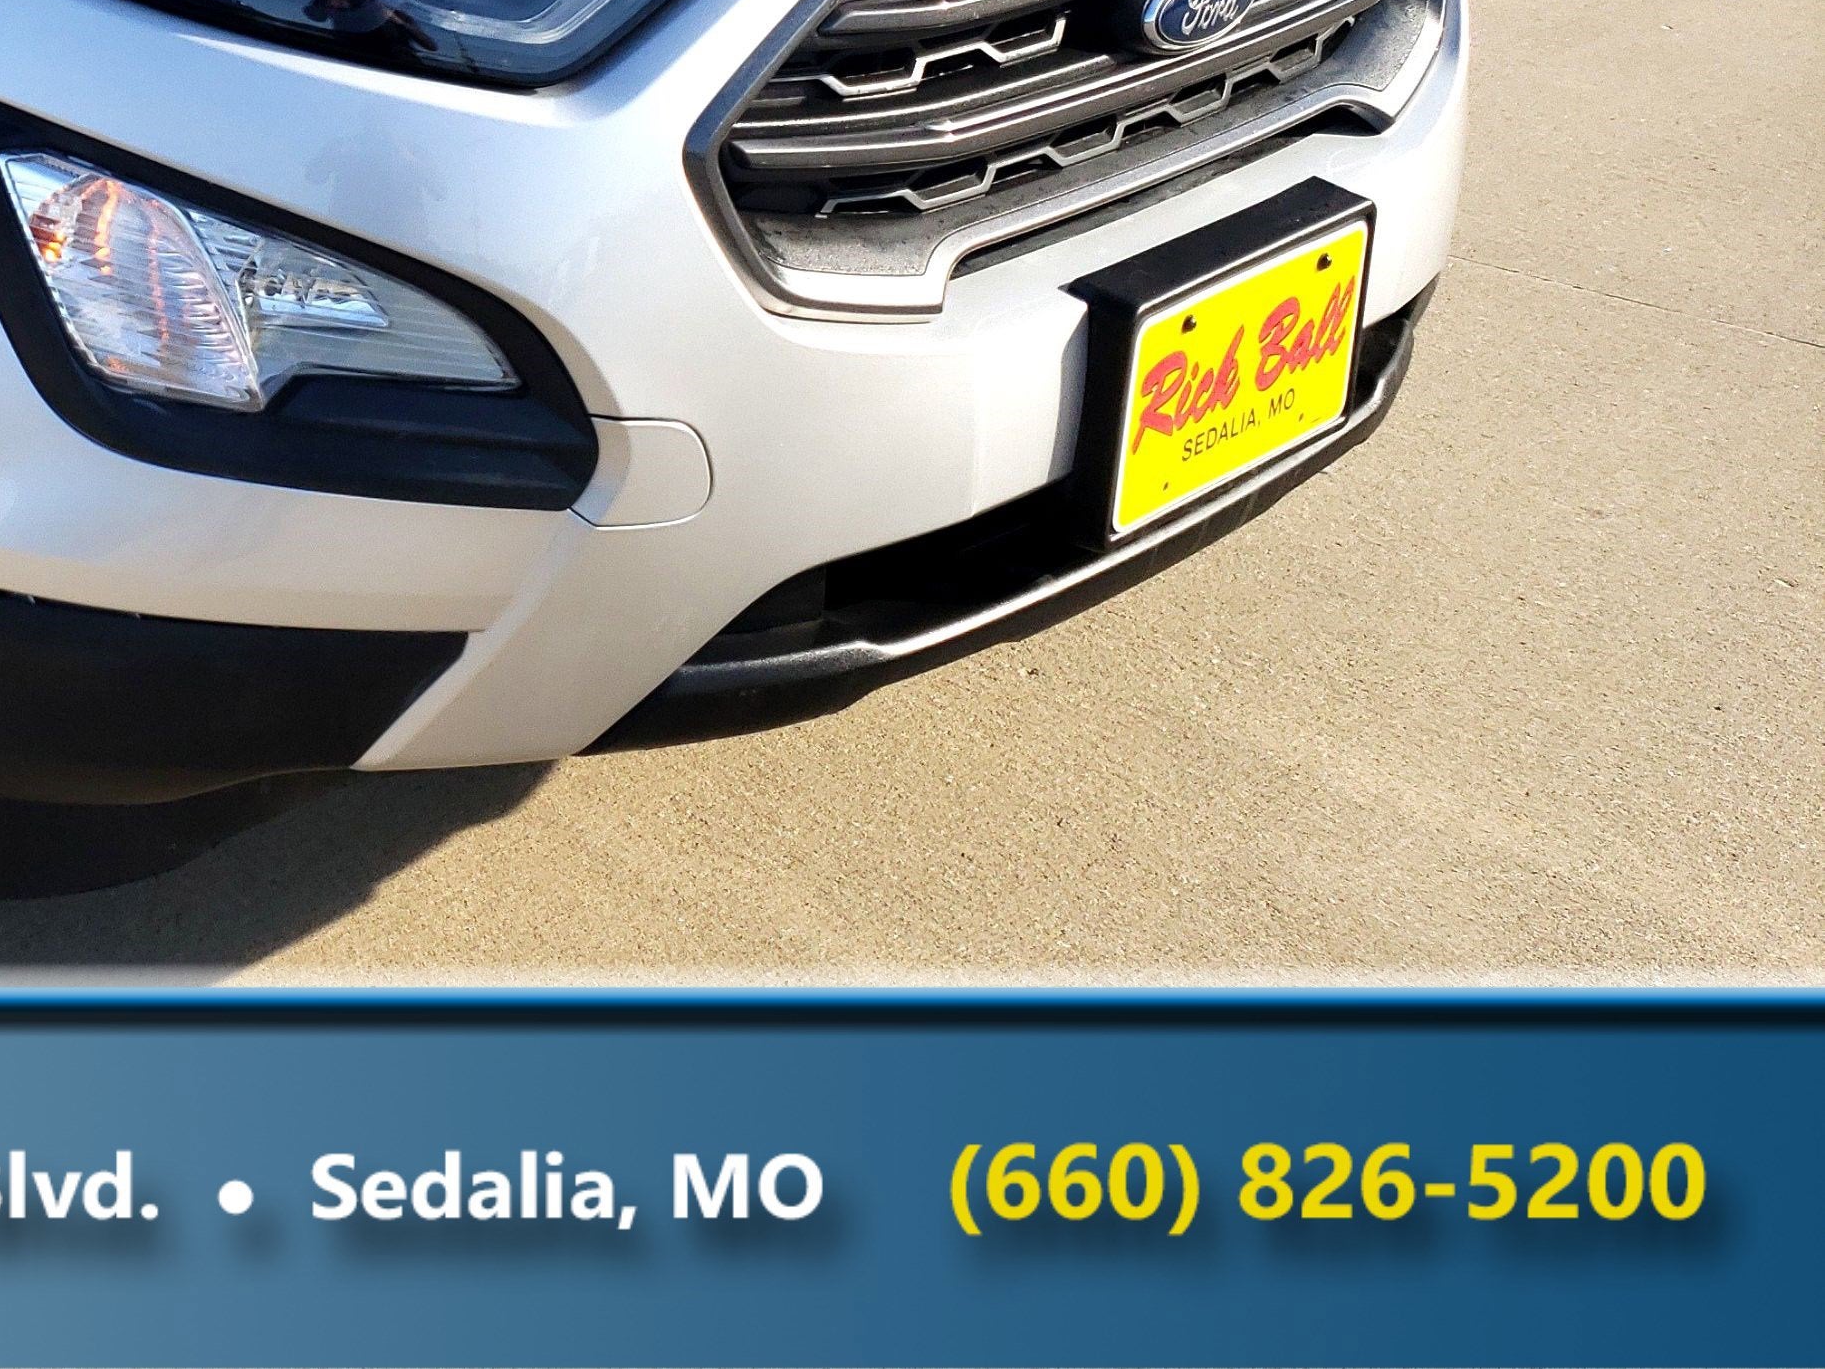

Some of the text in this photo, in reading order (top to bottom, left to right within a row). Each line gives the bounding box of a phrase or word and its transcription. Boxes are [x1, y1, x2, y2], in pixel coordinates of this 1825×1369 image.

[1131, 274, 1356, 456] Rick Ball
[1181, 388, 1296, 462] SEDALIA, MO
